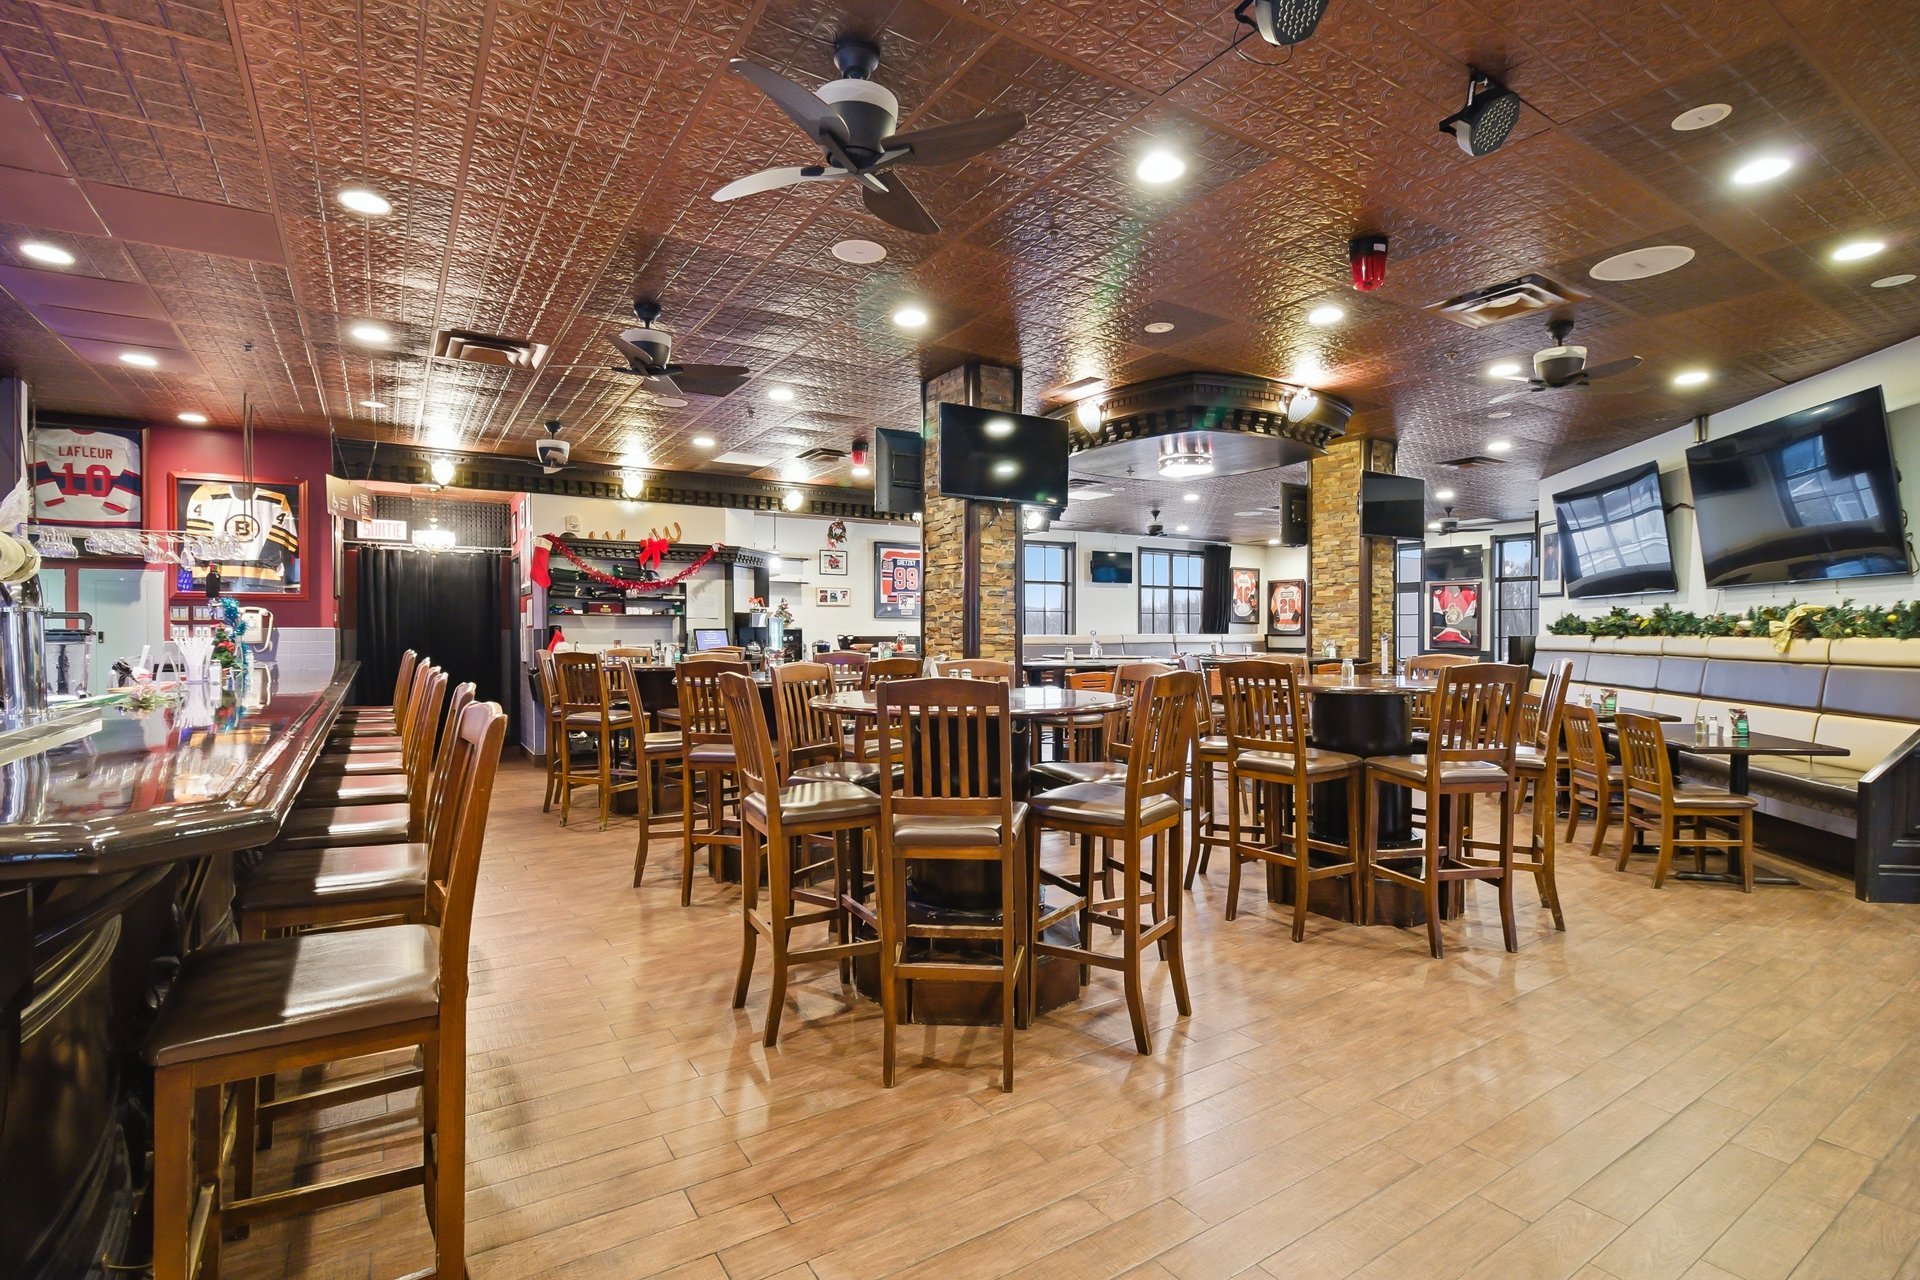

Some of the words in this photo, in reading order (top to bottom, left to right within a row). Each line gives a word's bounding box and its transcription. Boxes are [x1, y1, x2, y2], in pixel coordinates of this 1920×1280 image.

[58, 446, 113, 459] LAFLEUR
[62, 463, 111, 497] 10
[193, 504, 203, 516] 4
[276, 513, 287, 525] 4
[235, 520, 251, 536] B
[363, 522, 402, 538] SORTIE
[893, 567, 919, 590] 99
